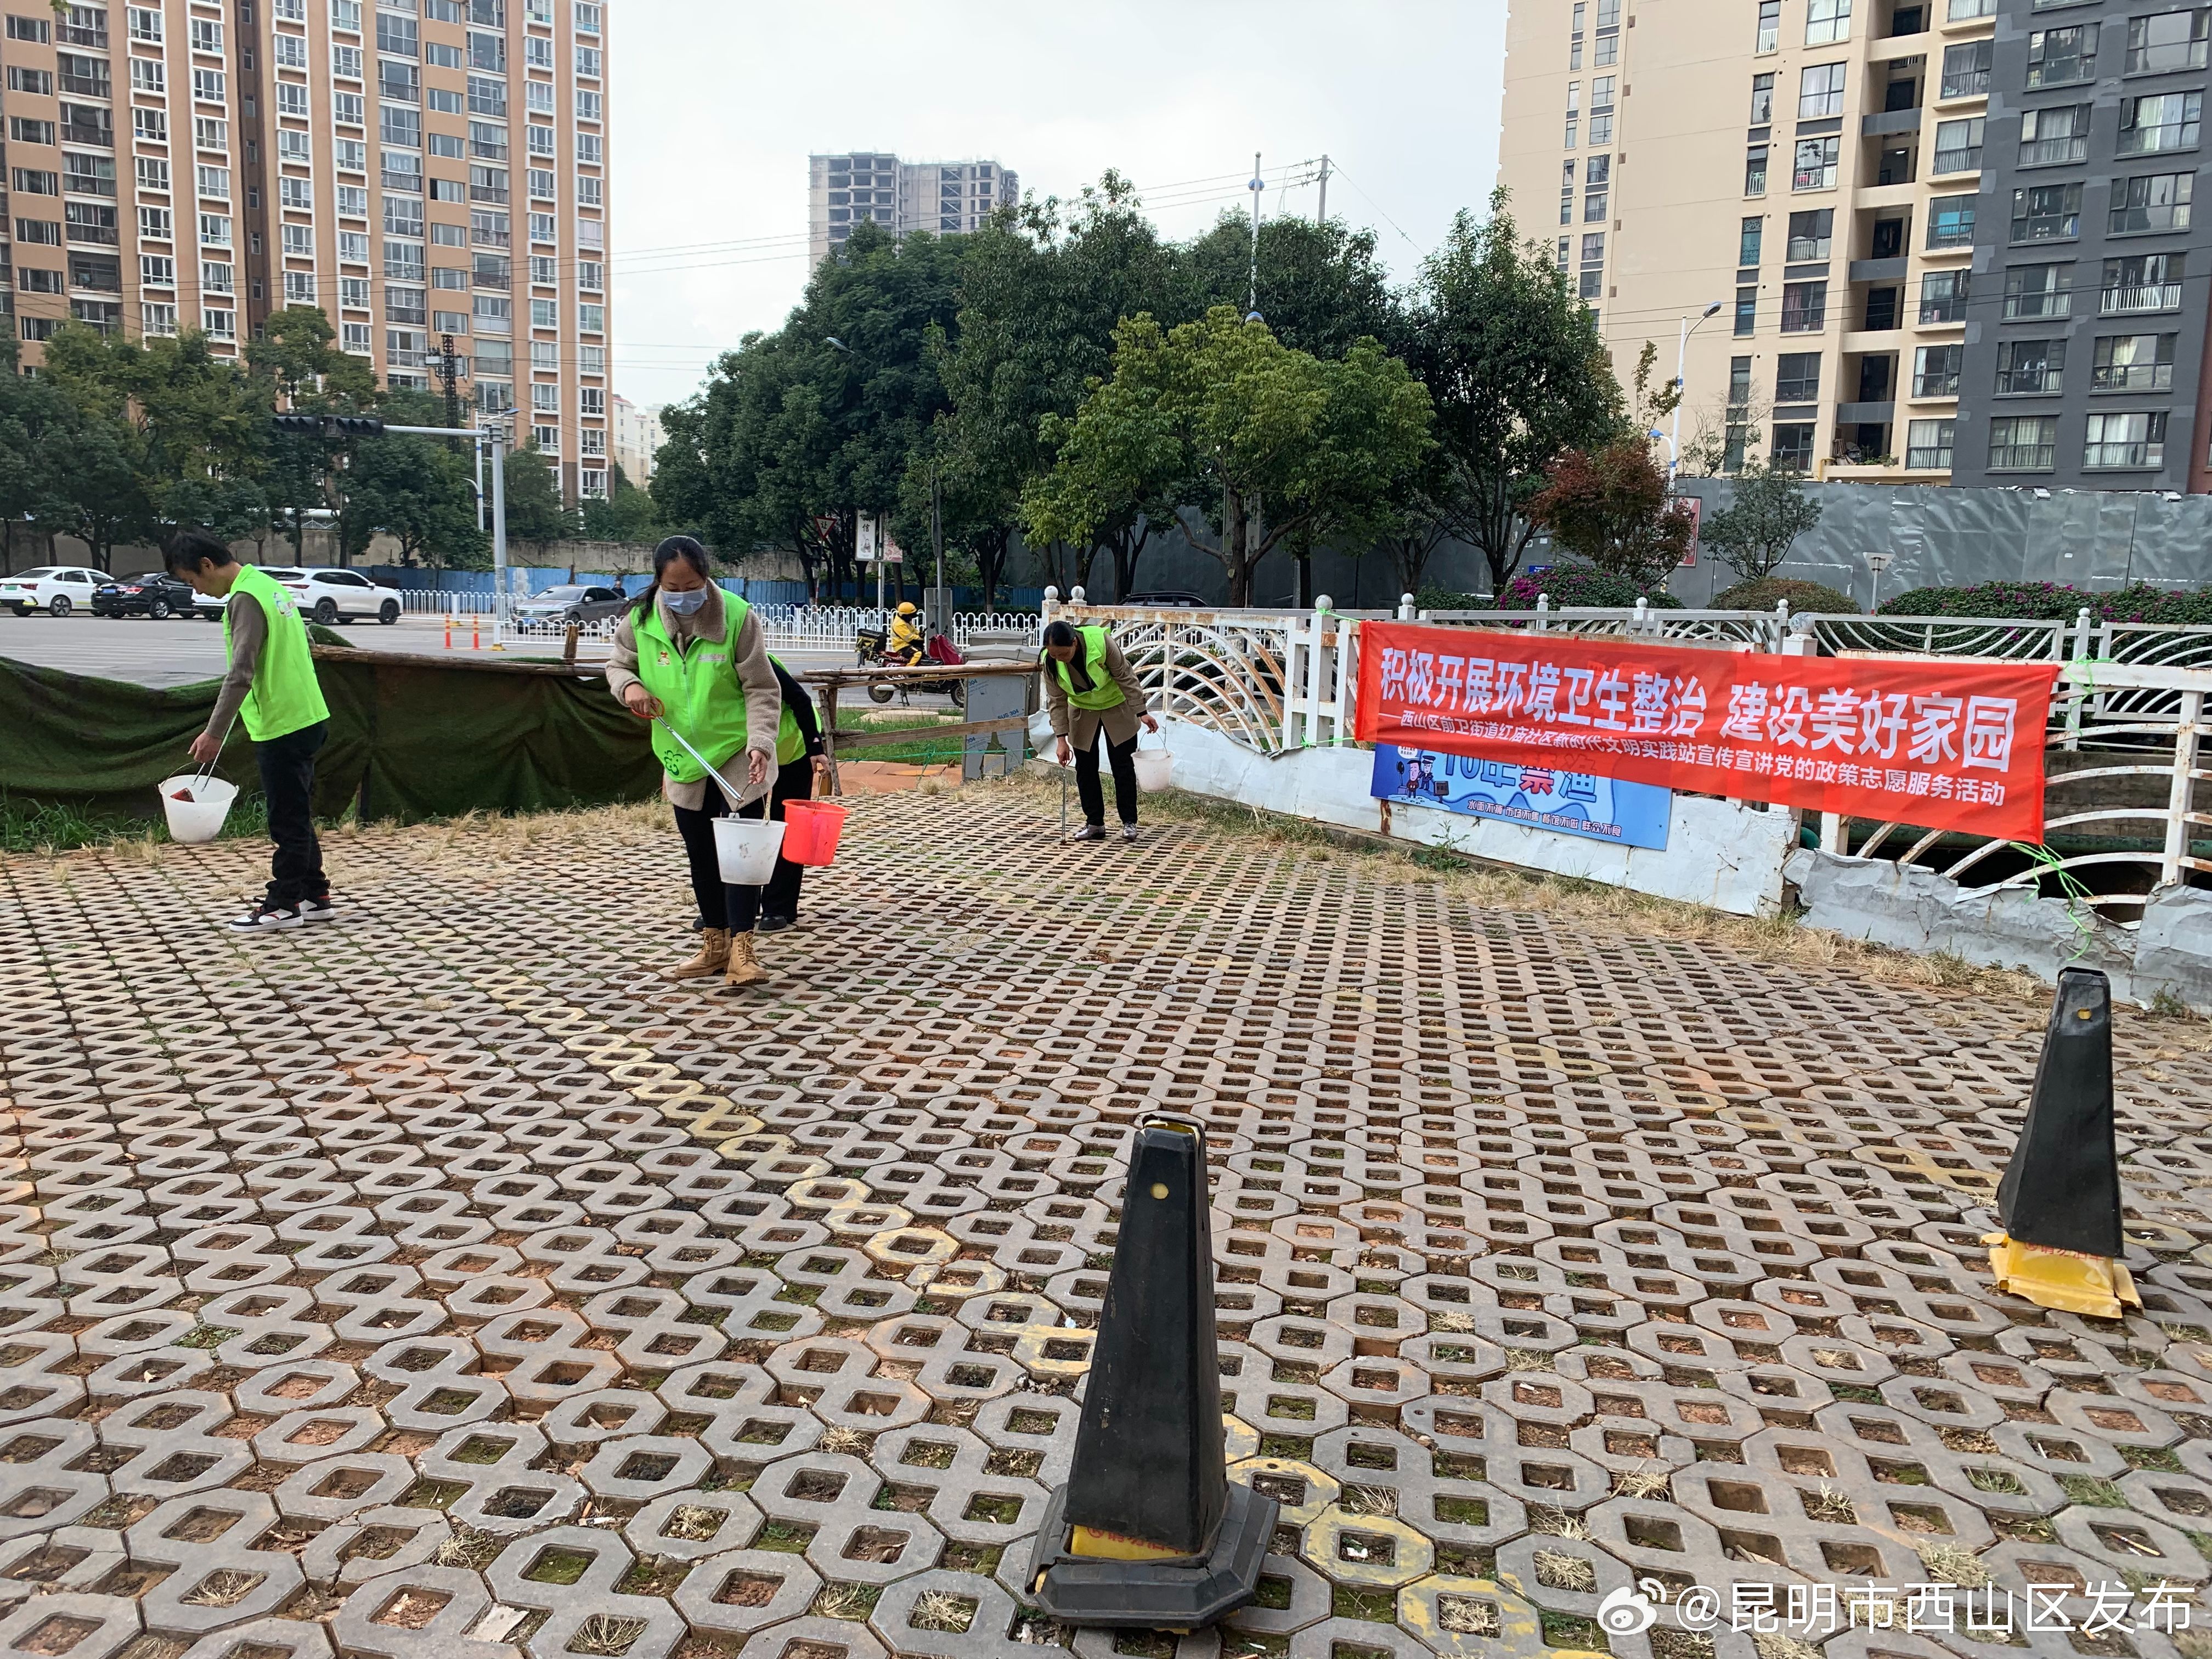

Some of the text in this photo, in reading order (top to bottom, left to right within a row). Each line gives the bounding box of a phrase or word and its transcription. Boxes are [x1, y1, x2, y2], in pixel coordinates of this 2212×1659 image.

[862, 523, 870, 533] 信
[1380, 647, 2018, 772] 积极开展环境卫生整治 建设美好家园
[1505, 806, 1540, 823] 市场不售
[1542, 812, 1579, 830] 餐馆不做
[1582, 820, 1622, 837] 群众不食
